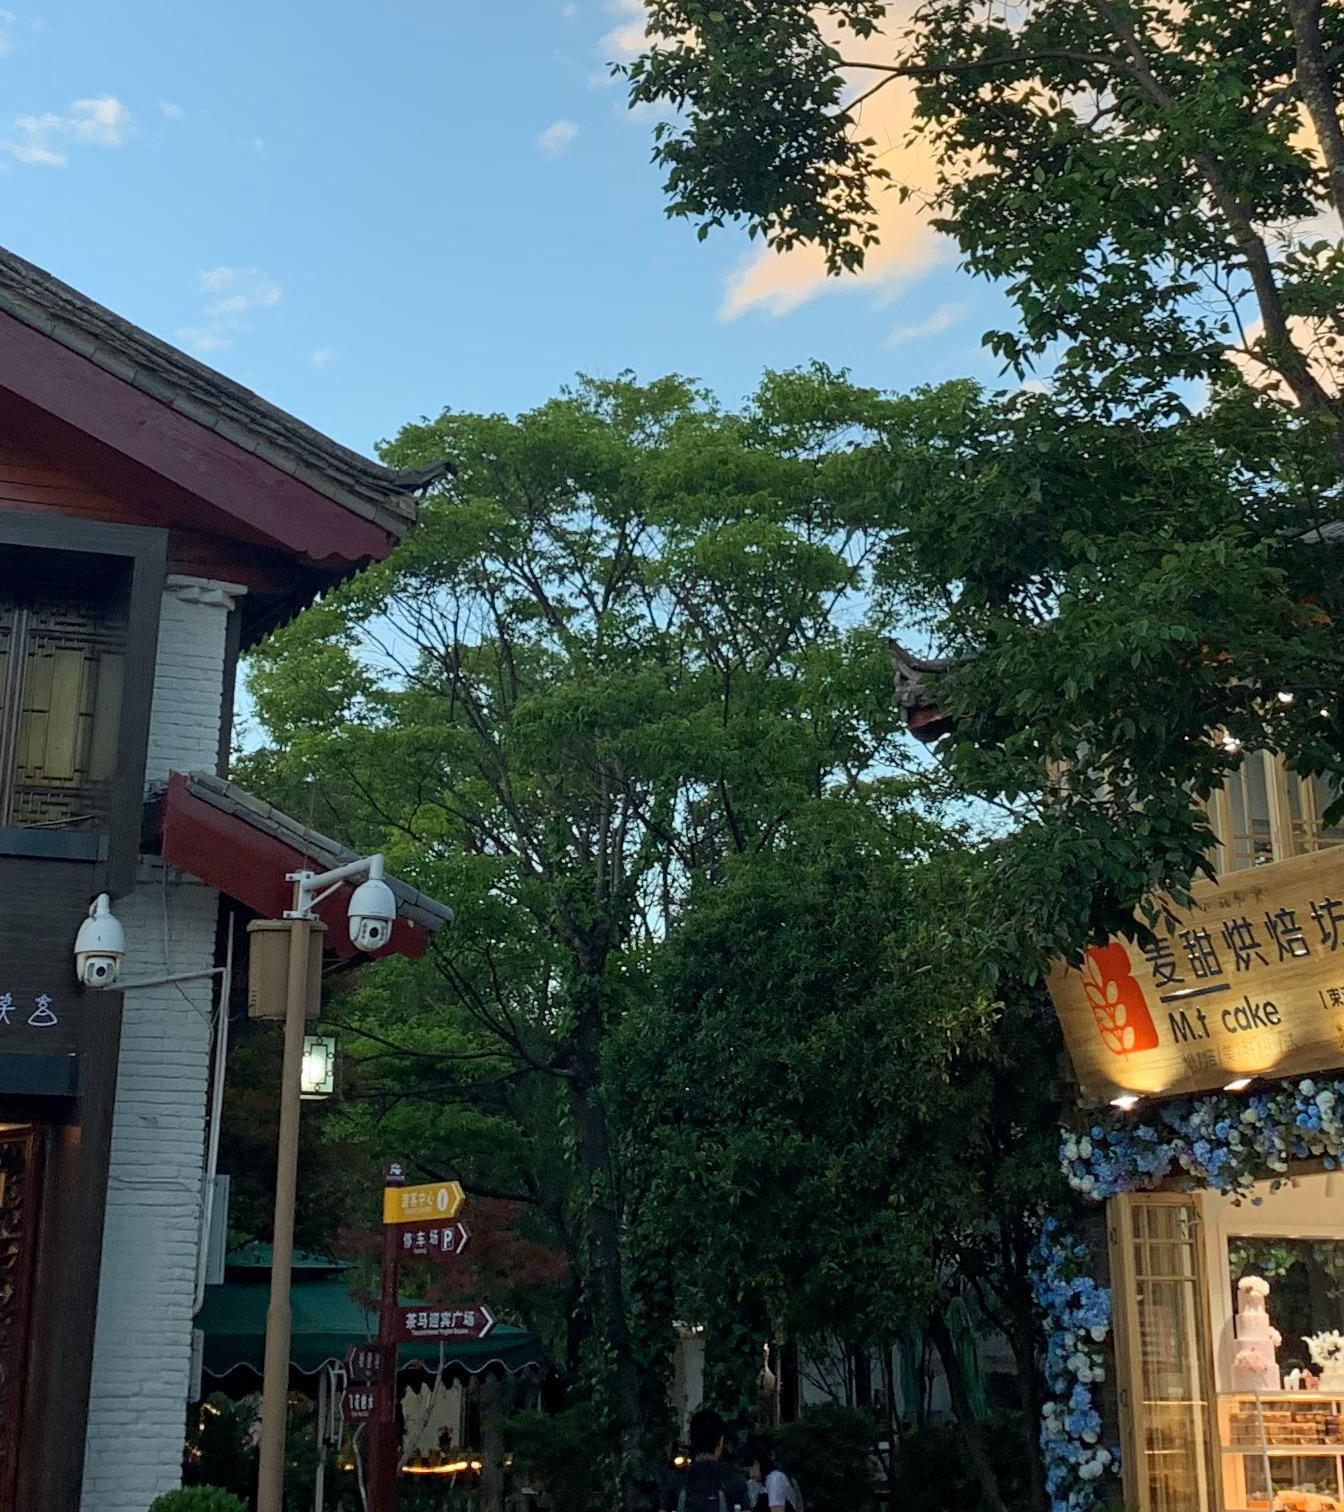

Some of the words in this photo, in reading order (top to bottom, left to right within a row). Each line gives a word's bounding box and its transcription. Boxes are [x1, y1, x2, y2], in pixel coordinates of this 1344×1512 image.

[1221, 995, 1282, 1034] cake
[403, 1228, 439, 1249] 停车场
